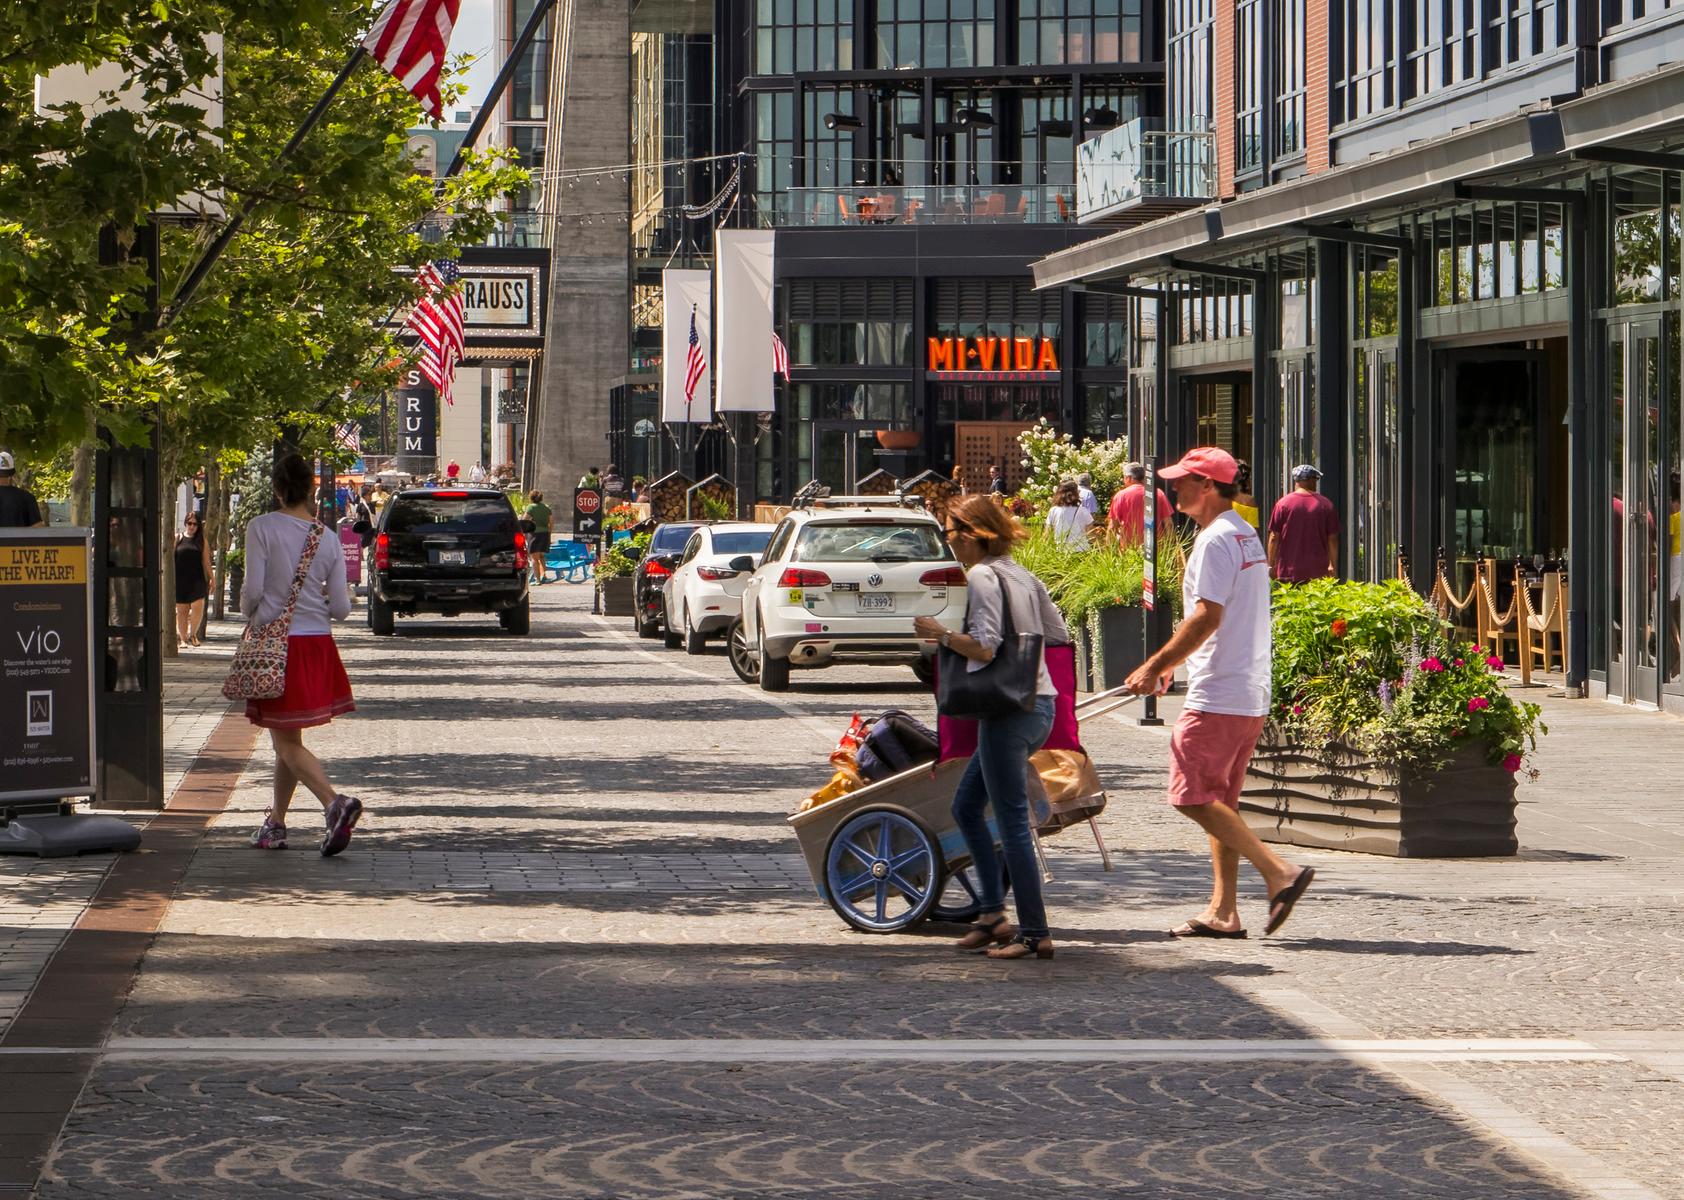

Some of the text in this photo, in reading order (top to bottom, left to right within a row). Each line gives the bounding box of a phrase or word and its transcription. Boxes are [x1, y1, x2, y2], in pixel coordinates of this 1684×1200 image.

[466, 281, 524, 310] RAUSS
[928, 337, 1058, 371] MI VIDA
[578, 497, 598, 507] STOP
[12, 549, 59, 564] LIVE AT
[0, 566, 75, 581] THE WHARF!
